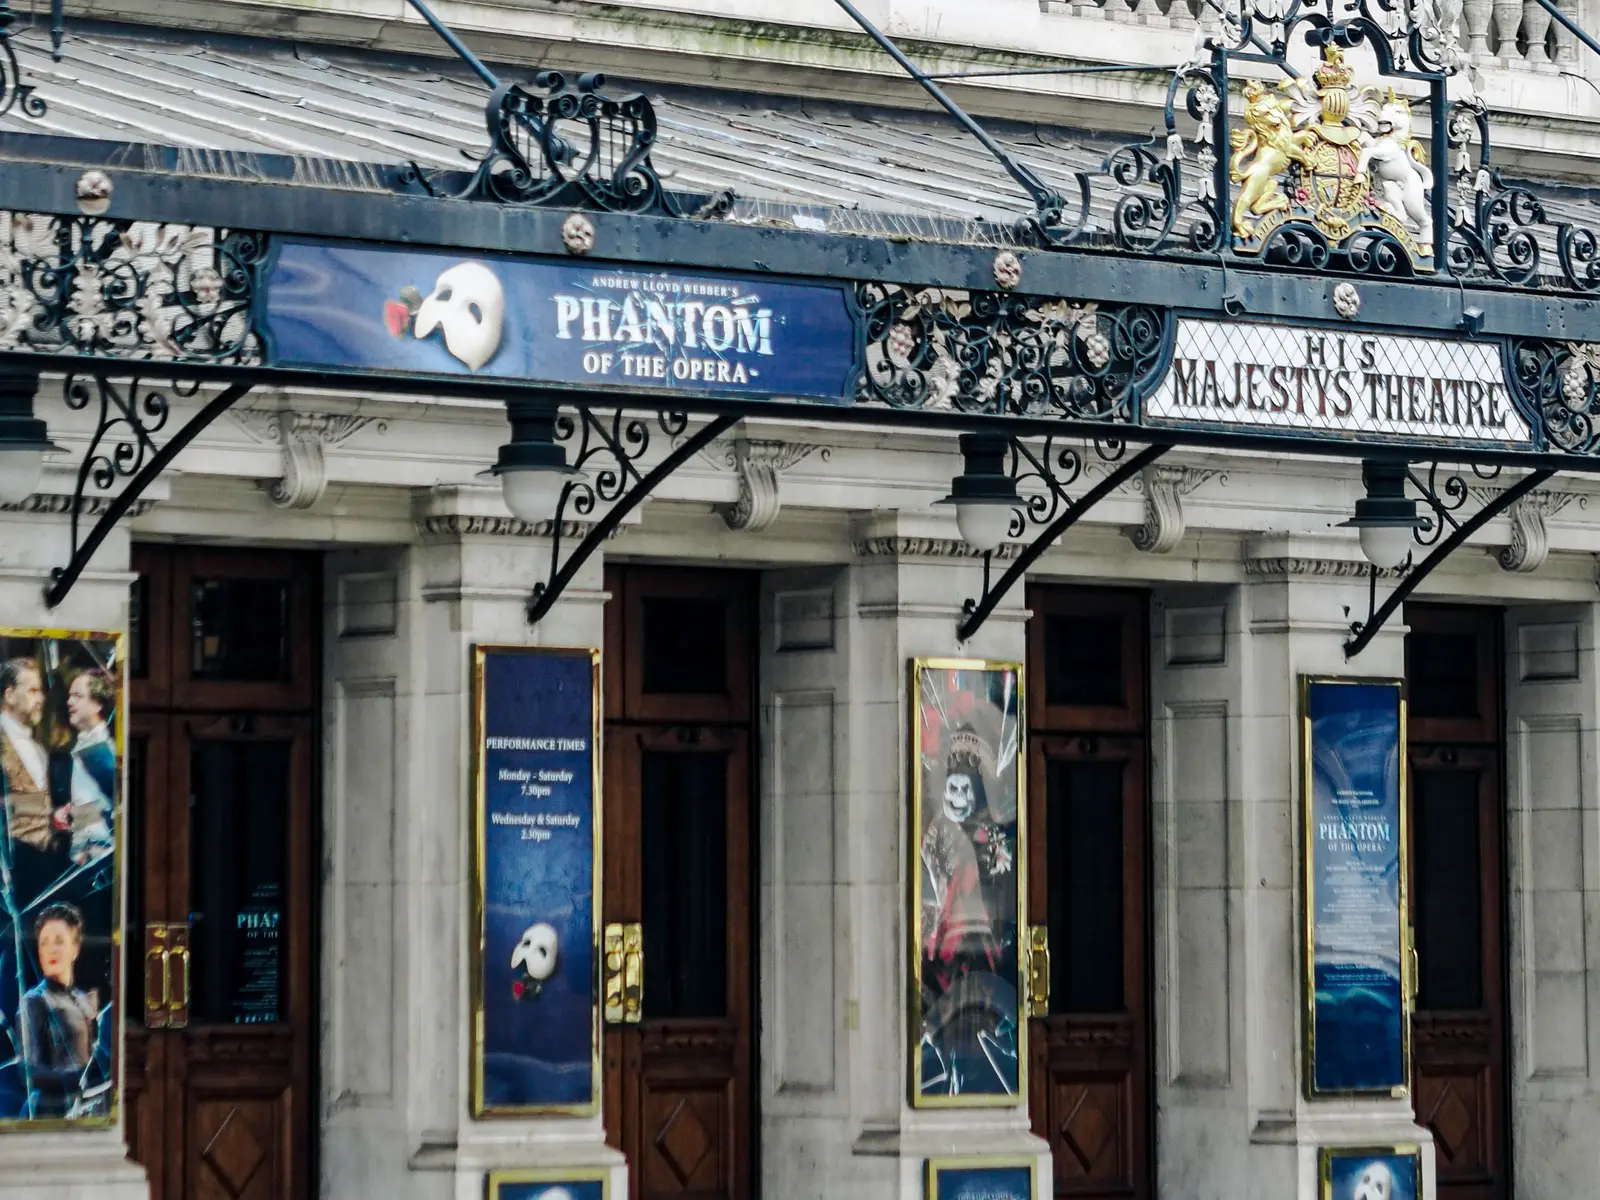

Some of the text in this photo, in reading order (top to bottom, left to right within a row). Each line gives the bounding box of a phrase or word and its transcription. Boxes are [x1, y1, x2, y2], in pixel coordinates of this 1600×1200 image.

[592, 276, 739, 298] ANDREW LLOYD WEBBER'S
[553, 291, 774, 356] PHANTOM
[1305, 335, 1377, 370] HIS
[583, 352, 748, 384] OF THE OPERA
[1173, 358, 1511, 429] MAJESTYS THEATRE
[486, 737, 586, 751] PERFORMANCE TIMES
[498, 769, 531, 783] Monday
[538, 769, 573, 784] Saturday
[520, 785, 551, 798] 7.30pm
[491, 812, 580, 828] Wednesday & Saturday
[520, 829, 551, 843] 2.30pm
[1319, 820, 1391, 842] PHANTOM
[1341, 842, 1355, 852] THE
[1357, 842, 1383, 853] OPERA
